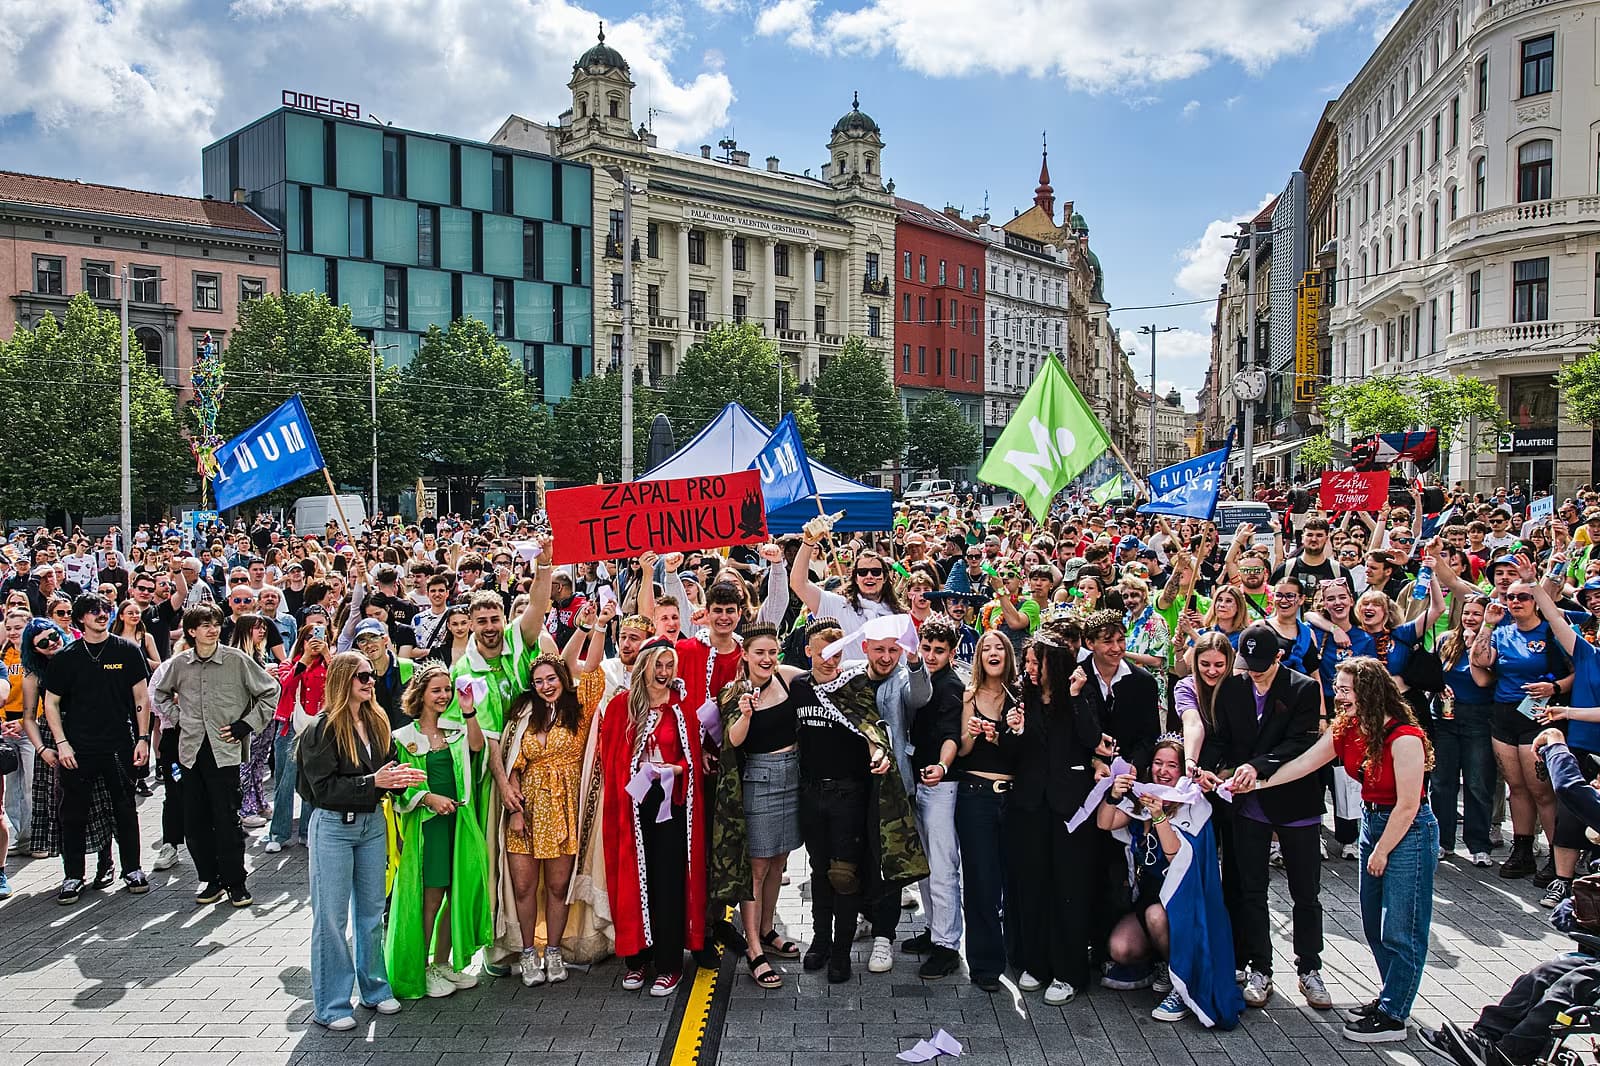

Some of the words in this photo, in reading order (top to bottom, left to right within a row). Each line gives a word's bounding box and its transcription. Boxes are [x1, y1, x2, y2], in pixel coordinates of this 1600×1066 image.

[282, 89, 360, 119] OMEGA
[712, 214, 736, 224] NADACE
[738, 218, 770, 230] VALENTINA
[1515, 438, 1555, 447] SALATERIE
[601, 480, 680, 511] ZÁPAL
[687, 476, 726, 501] PRO
[1334, 494, 1369, 504] TECHNIKU
[579, 505, 736, 555] TECHNIKU
